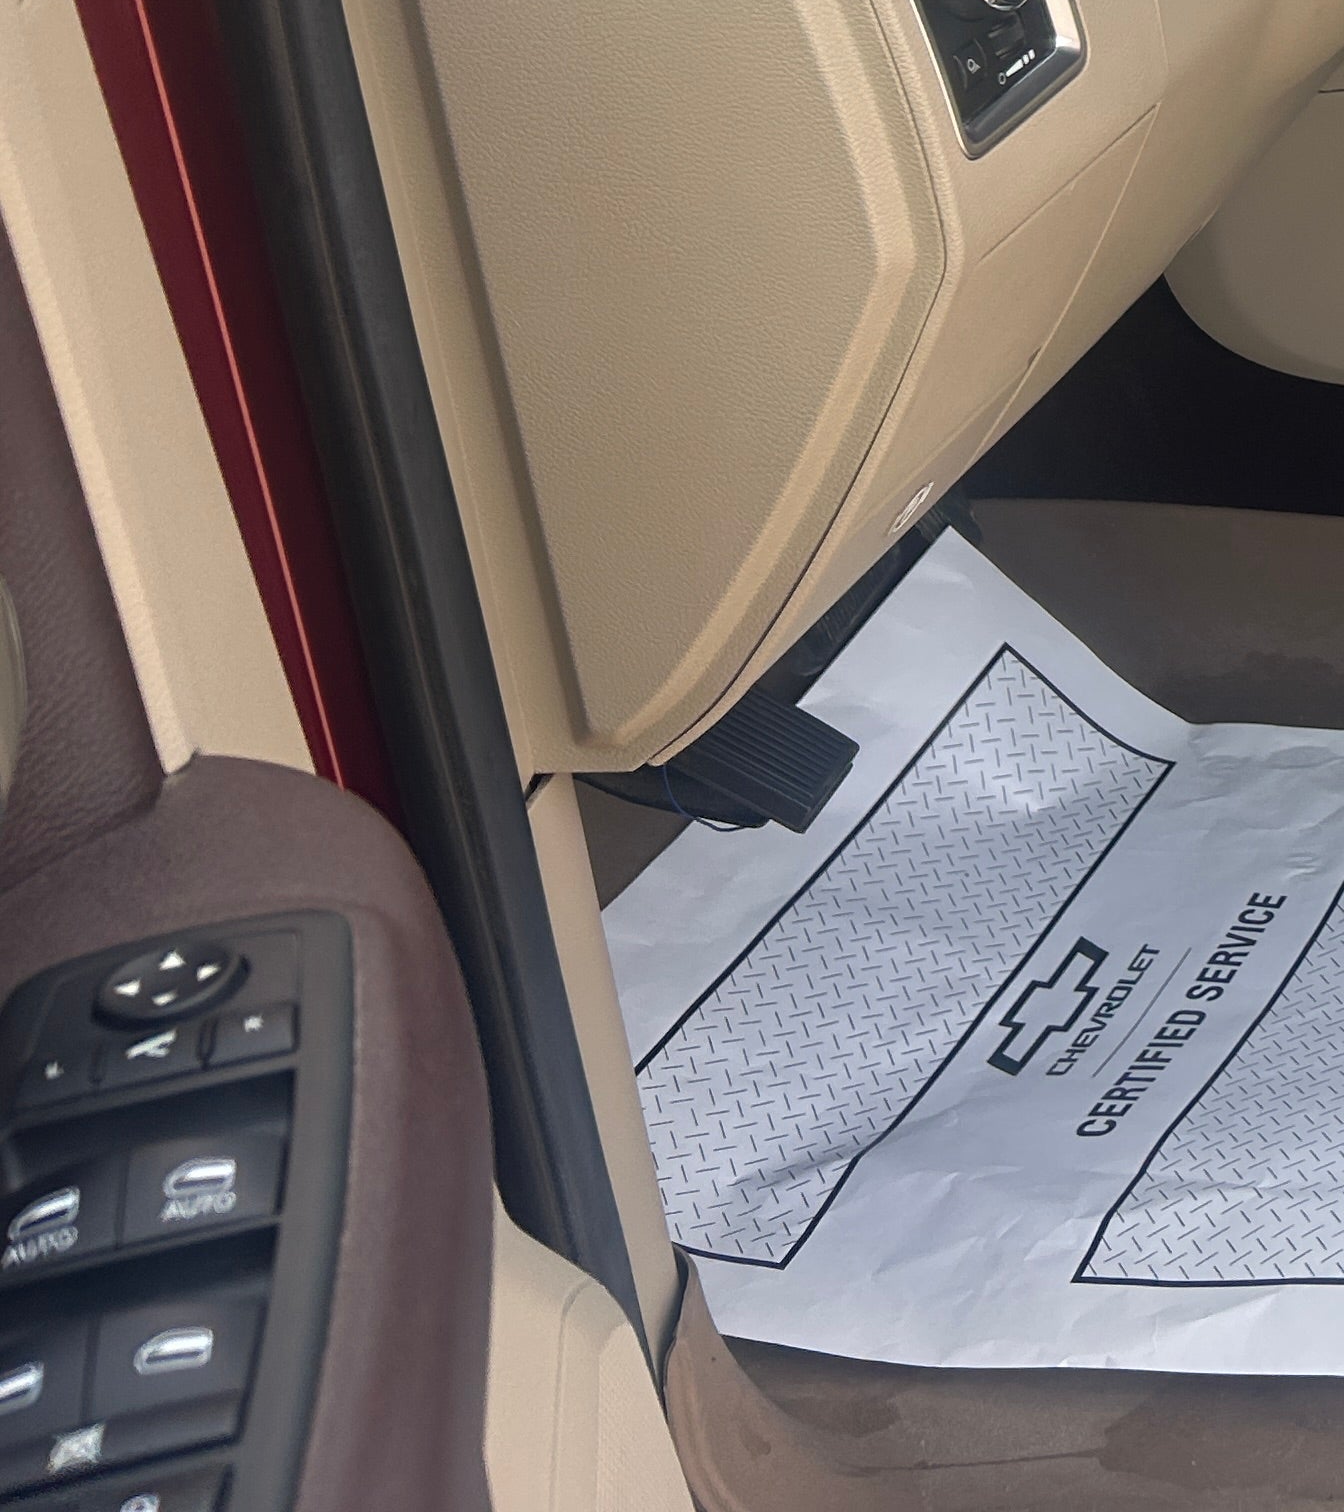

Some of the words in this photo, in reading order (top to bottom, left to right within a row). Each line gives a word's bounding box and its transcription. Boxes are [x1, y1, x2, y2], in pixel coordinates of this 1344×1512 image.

[1046, 943, 1160, 1076] CHEVROLET
[1076, 1009, 1207, 1137] CERTIFIED
[1185, 892, 1287, 1002] SERVICE
[160, 1190, 237, 1223] AUTO
